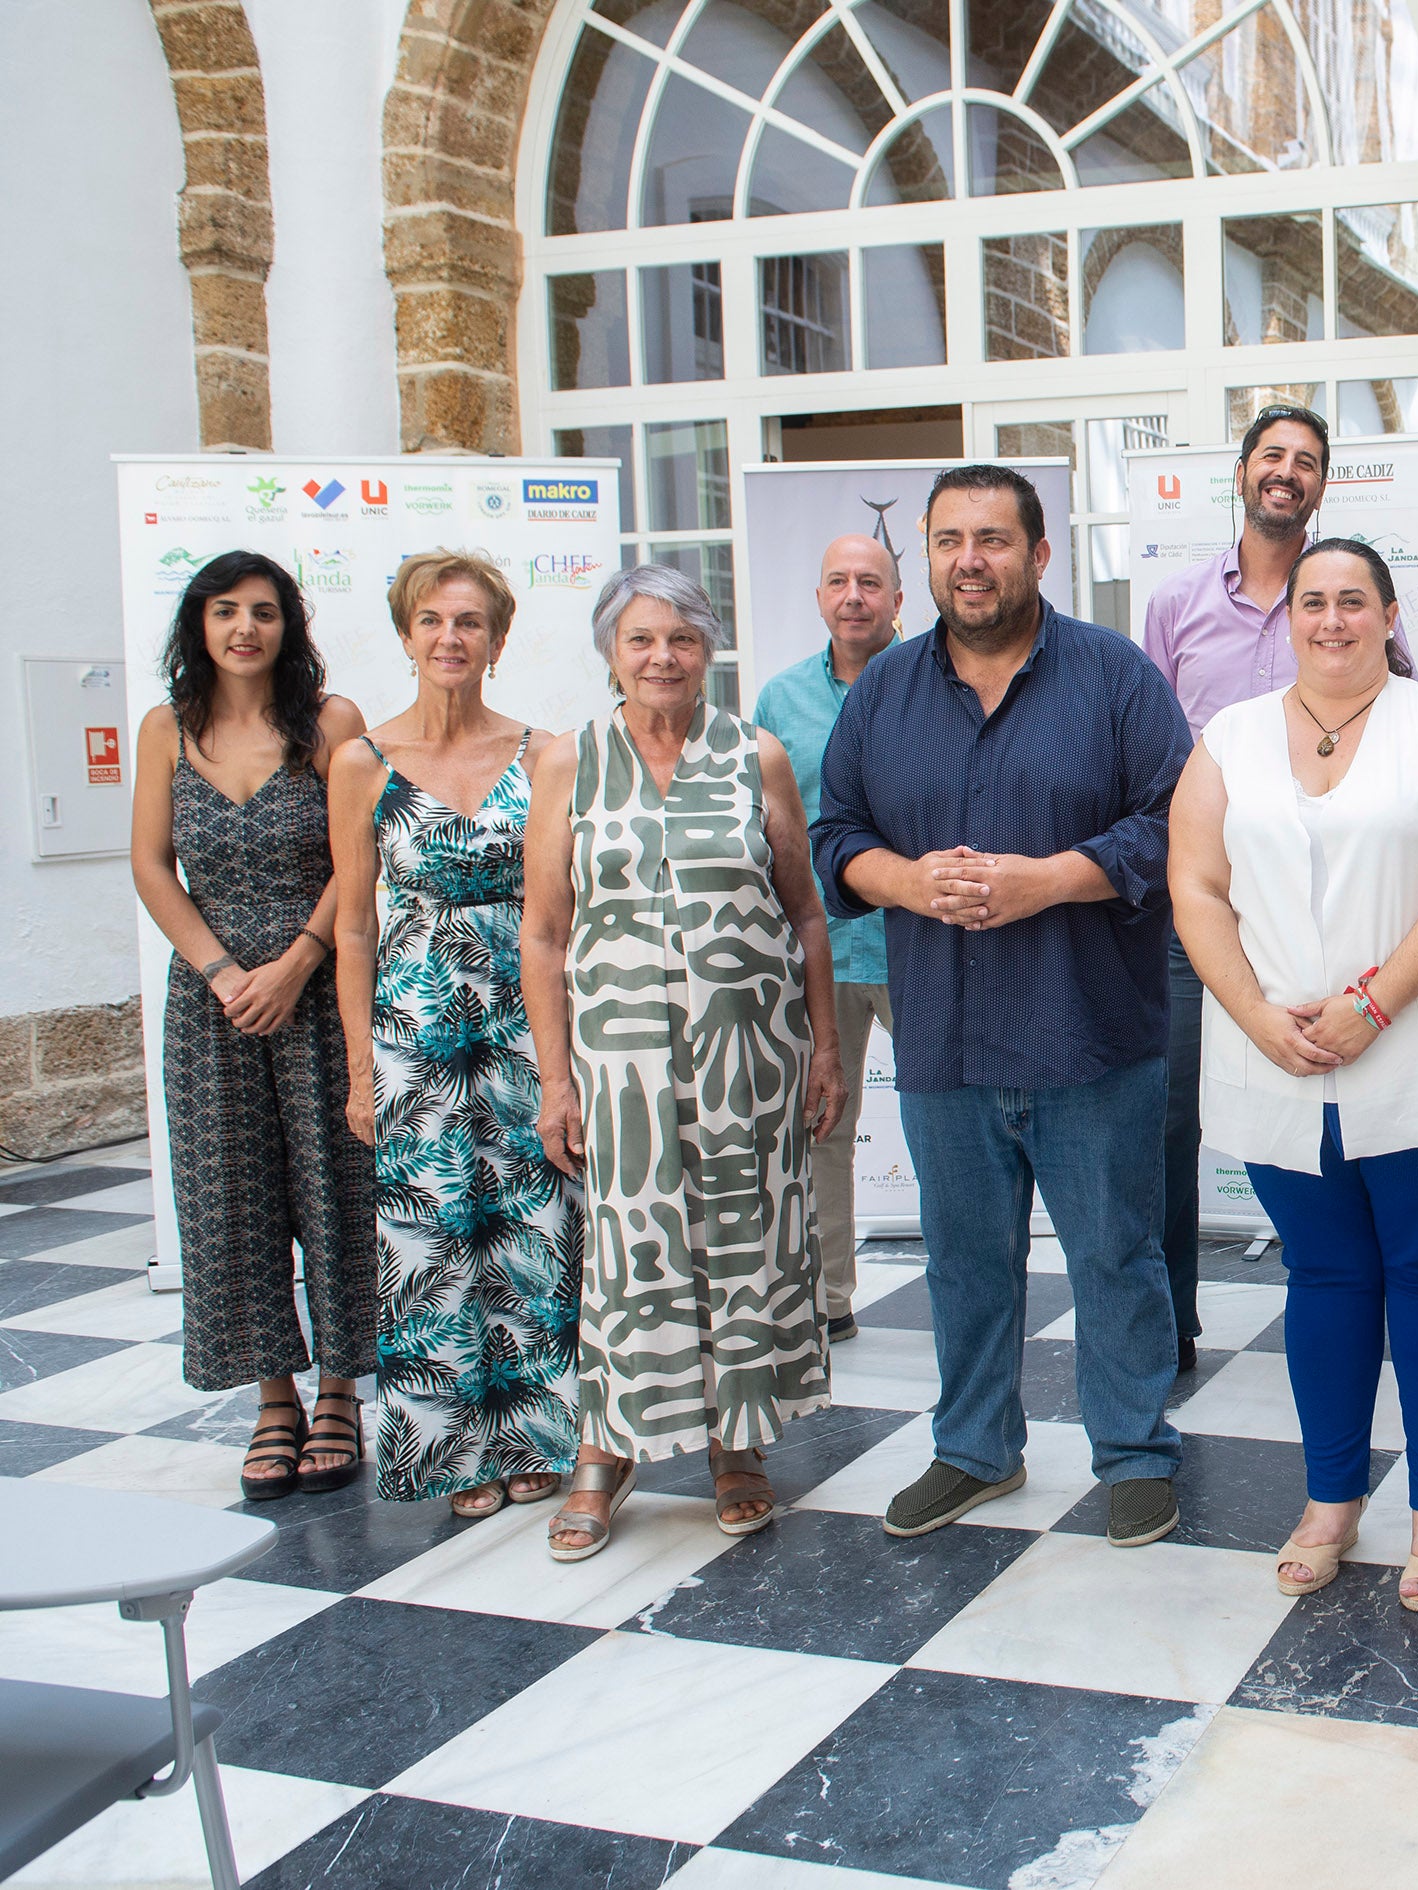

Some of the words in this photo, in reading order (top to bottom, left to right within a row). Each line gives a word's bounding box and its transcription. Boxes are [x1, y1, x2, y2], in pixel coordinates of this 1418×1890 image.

[1337, 466, 1354, 479] DE
[1356, 463, 1394, 478] CADIZ
[404, 483, 453, 492] thermomix
[528, 482, 592, 499] makro
[1211, 495, 1244, 503] VORWE
[404, 501, 453, 510] VORWERK
[1157, 501, 1181, 510] UNIC
[361, 507, 389, 516] UNIC
[528, 509, 558, 518] DIARIO
[559, 510, 571, 518] DE
[572, 510, 597, 518] CADIZ
[296, 563, 352, 591] Janda
[1216, 1167, 1247, 1176] thermo
[1217, 1185, 1256, 1195] VORWER
